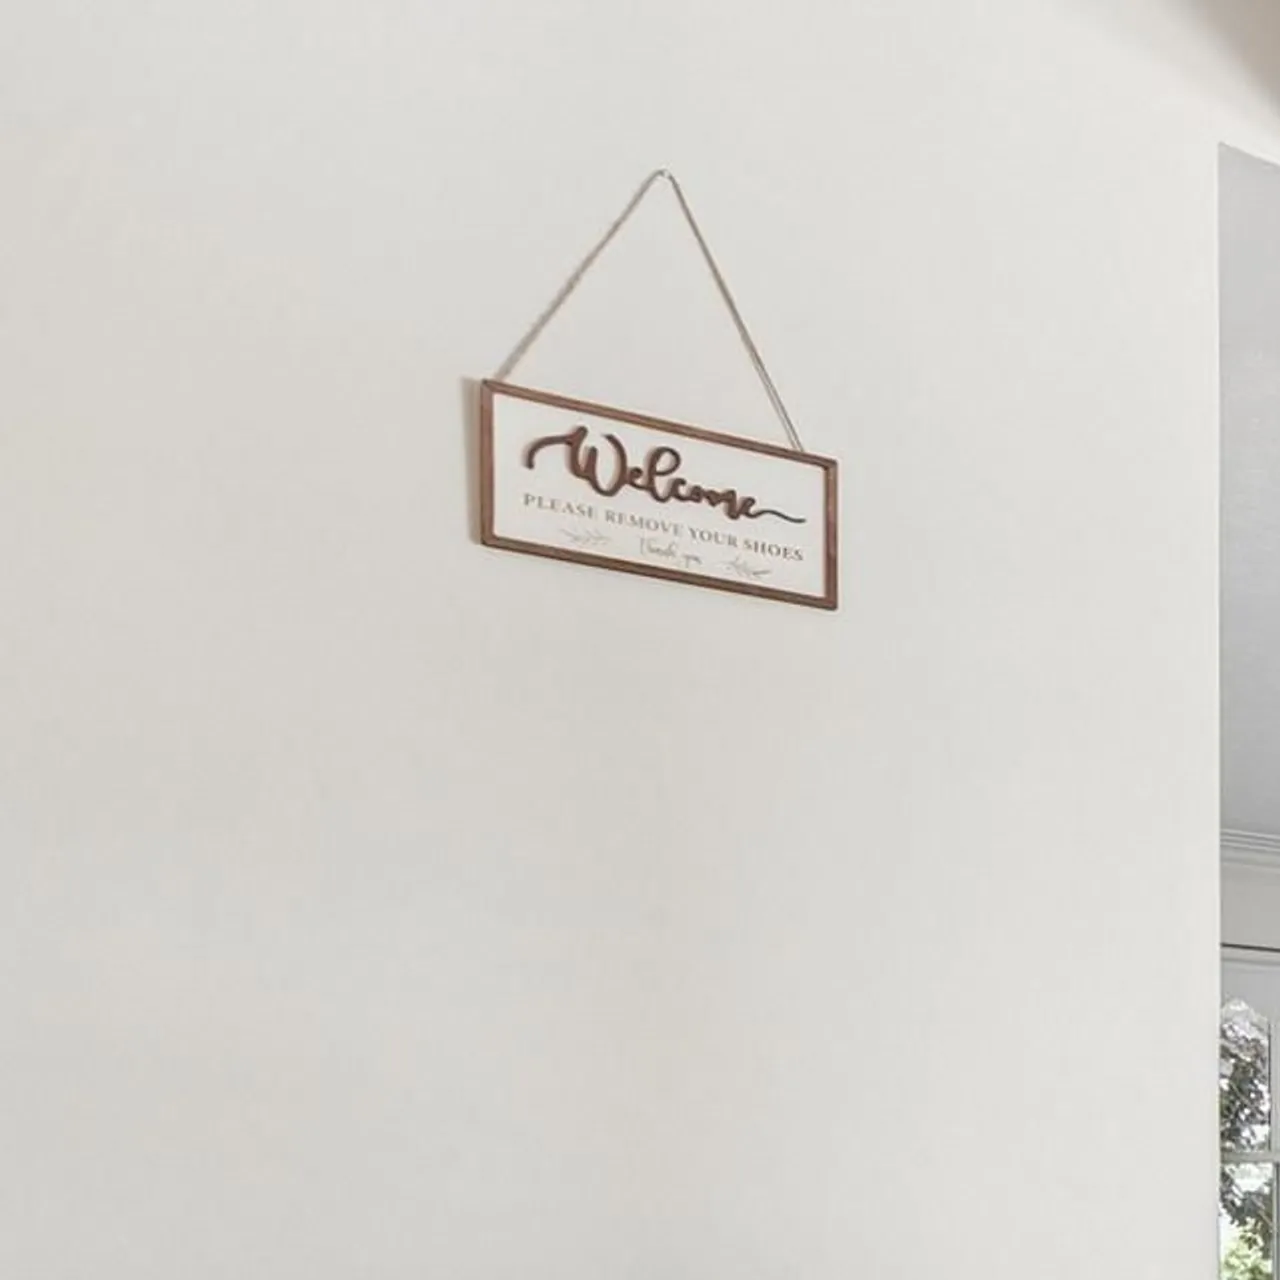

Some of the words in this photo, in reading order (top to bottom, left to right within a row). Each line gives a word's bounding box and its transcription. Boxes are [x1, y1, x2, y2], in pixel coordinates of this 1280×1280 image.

[524, 426, 806, 523] Welcome
[524, 494, 597, 520] PLEASE
[605, 510, 683, 538] REMOVE
[688, 527, 738, 549] YOUR
[744, 539, 804, 562] SHOES
